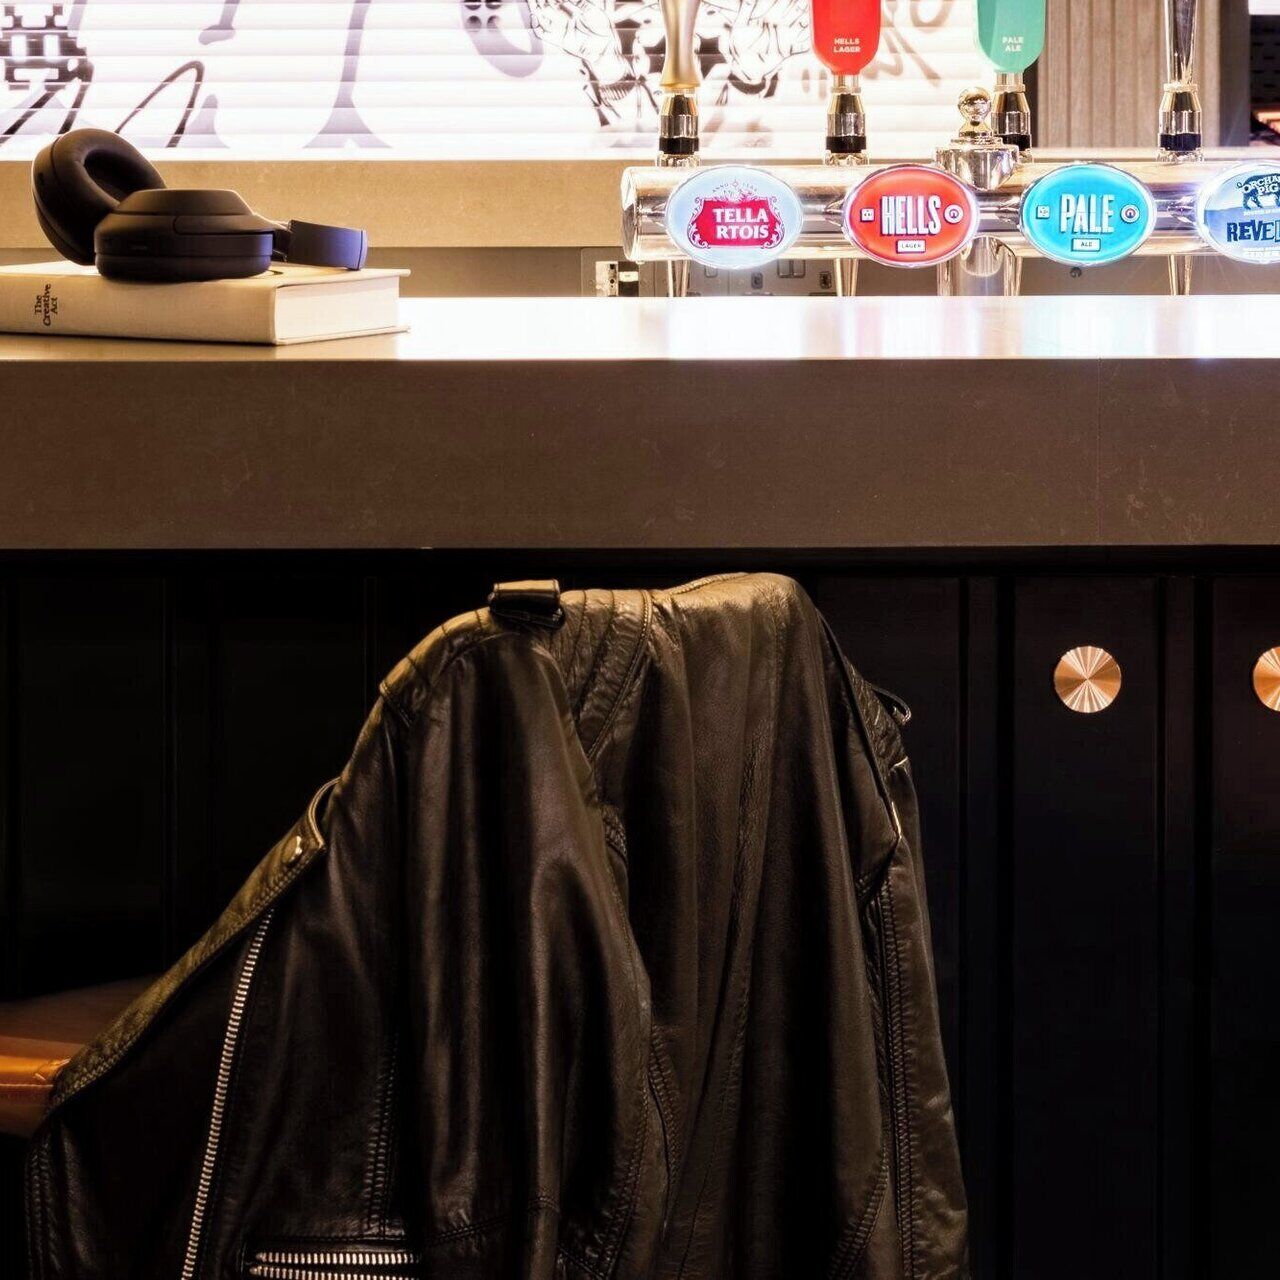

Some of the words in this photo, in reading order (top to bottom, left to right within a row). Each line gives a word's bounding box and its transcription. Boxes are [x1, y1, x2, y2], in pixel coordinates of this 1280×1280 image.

[833, 37, 860, 45] HELLS
[1001, 36, 1024, 44] PALE
[1257, 184, 1280, 197] PIG
[712, 207, 769, 223] TELLA
[880, 195, 942, 236] HELLS
[1060, 193, 1115, 235] PALE
[715, 224, 769, 240] RTOIS
[34, 295, 42, 315] The
[43, 283, 51, 326] Creative
[50, 297, 58, 315] Act
